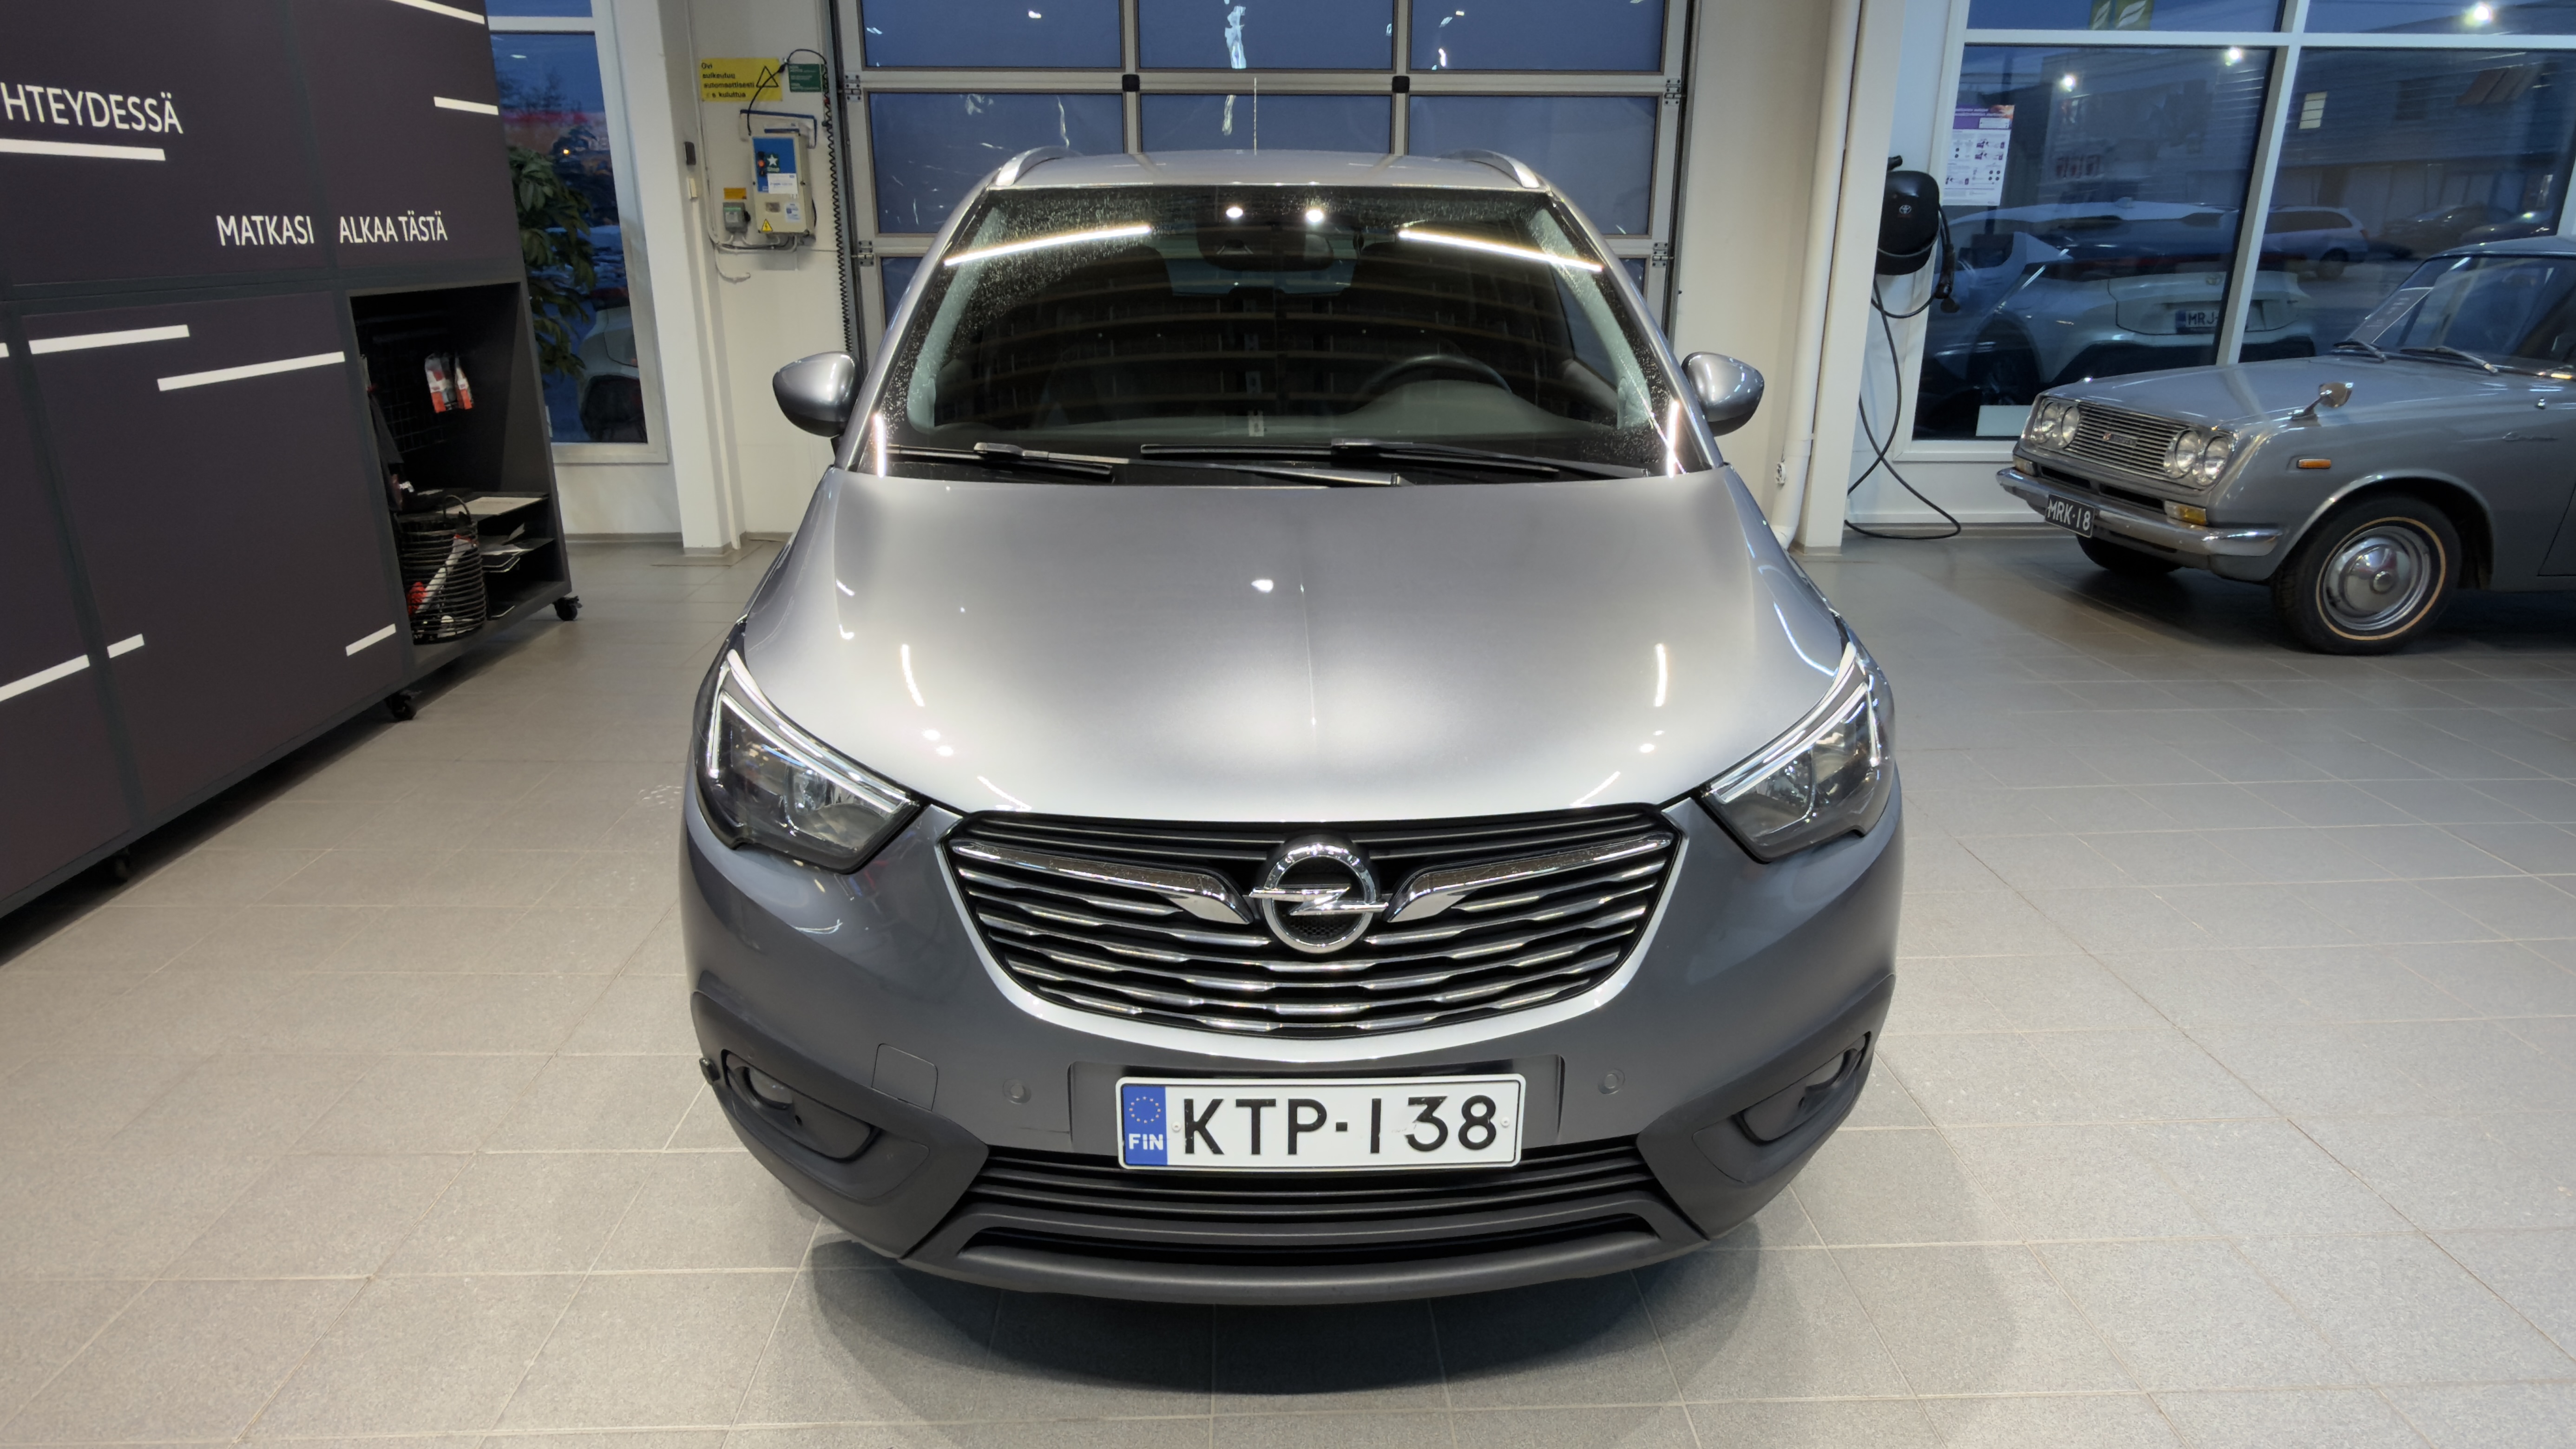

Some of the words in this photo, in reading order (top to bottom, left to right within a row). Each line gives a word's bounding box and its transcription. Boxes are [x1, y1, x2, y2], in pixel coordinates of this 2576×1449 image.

[0, 82, 184, 134] HTEYDESSÄ
[216, 215, 315, 246] MATKASI
[339, 216, 399, 244] ALKAA
[398, 210, 448, 242] TÄSTÄ
[2047, 498, 2091, 531] MRK-18
[1129, 1133, 1164, 1150] FIN
[1183, 1095, 1497, 1155] KTP-138
